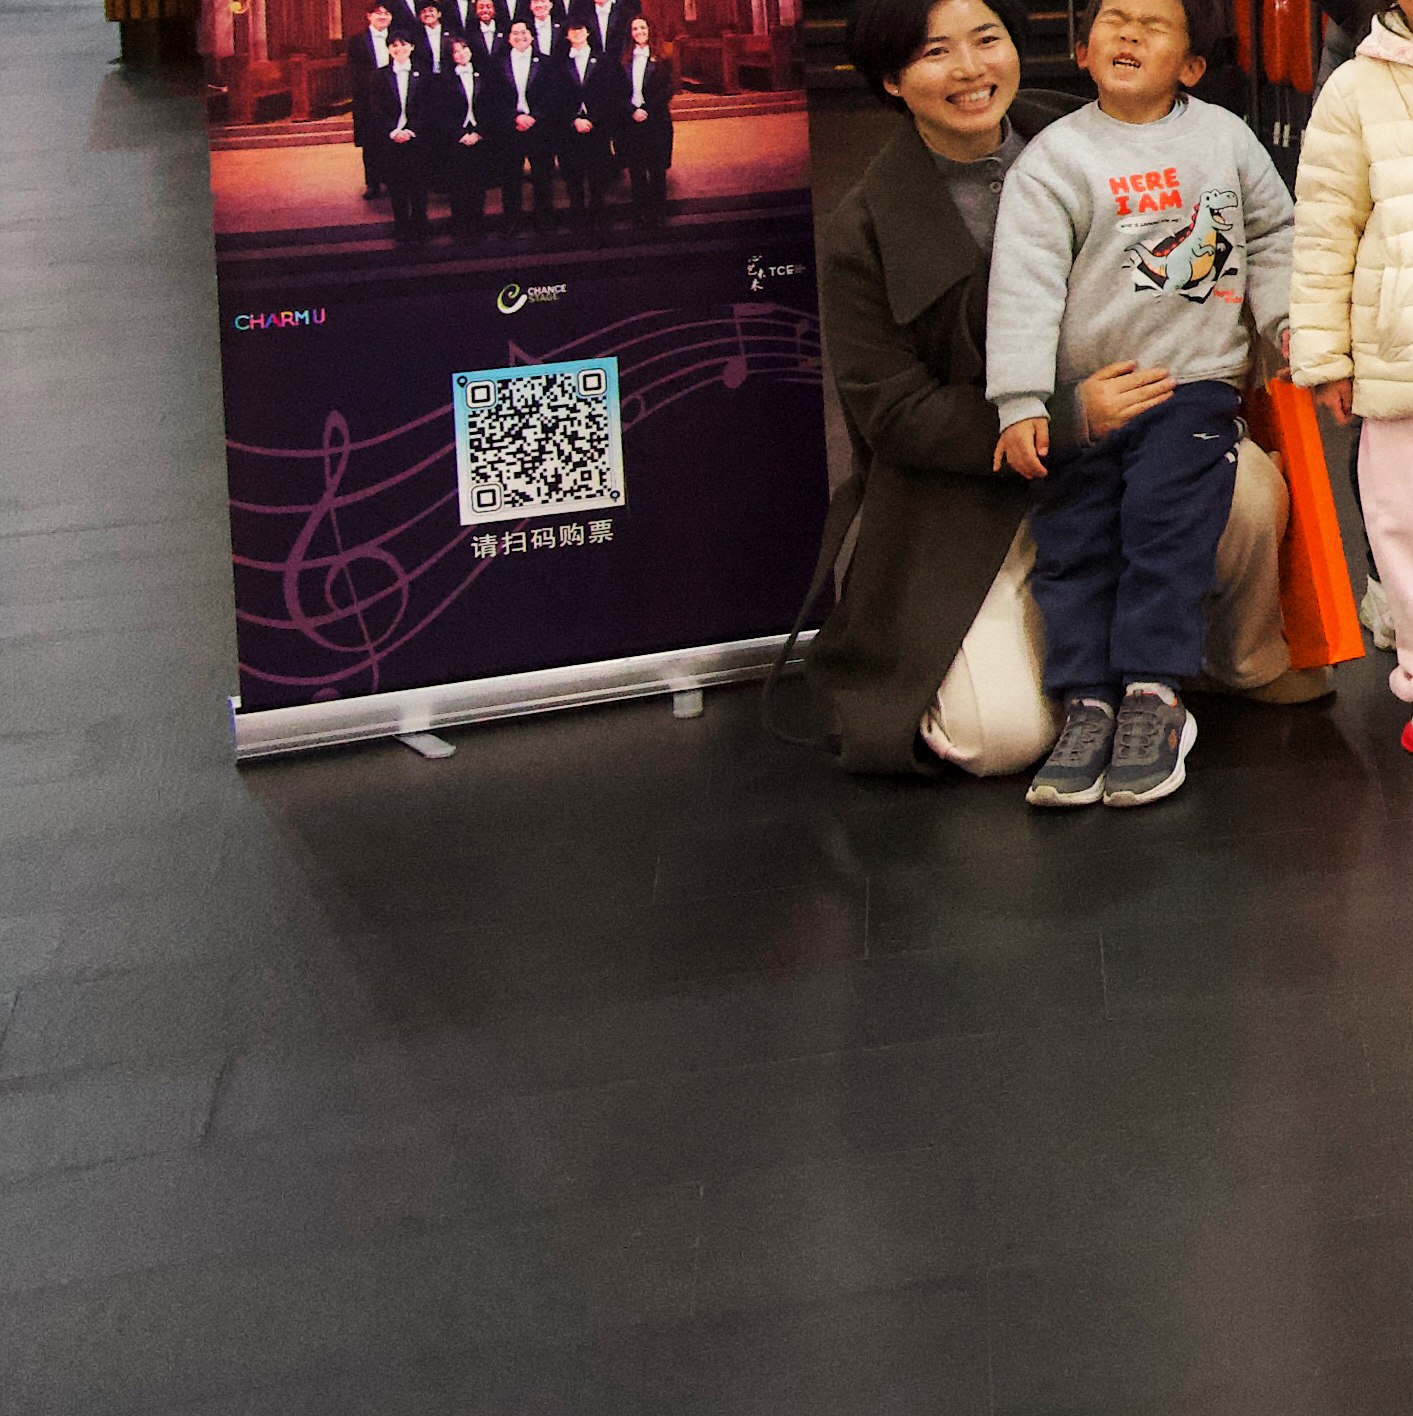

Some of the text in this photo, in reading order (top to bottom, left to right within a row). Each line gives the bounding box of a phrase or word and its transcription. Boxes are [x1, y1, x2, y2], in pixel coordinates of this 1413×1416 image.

[1109, 167, 1181, 196] HERE
[1115, 189, 1183, 217] I AM
[527, 283, 567, 297] CHANCE
[470, 518, 615, 560] 请扫码购票
